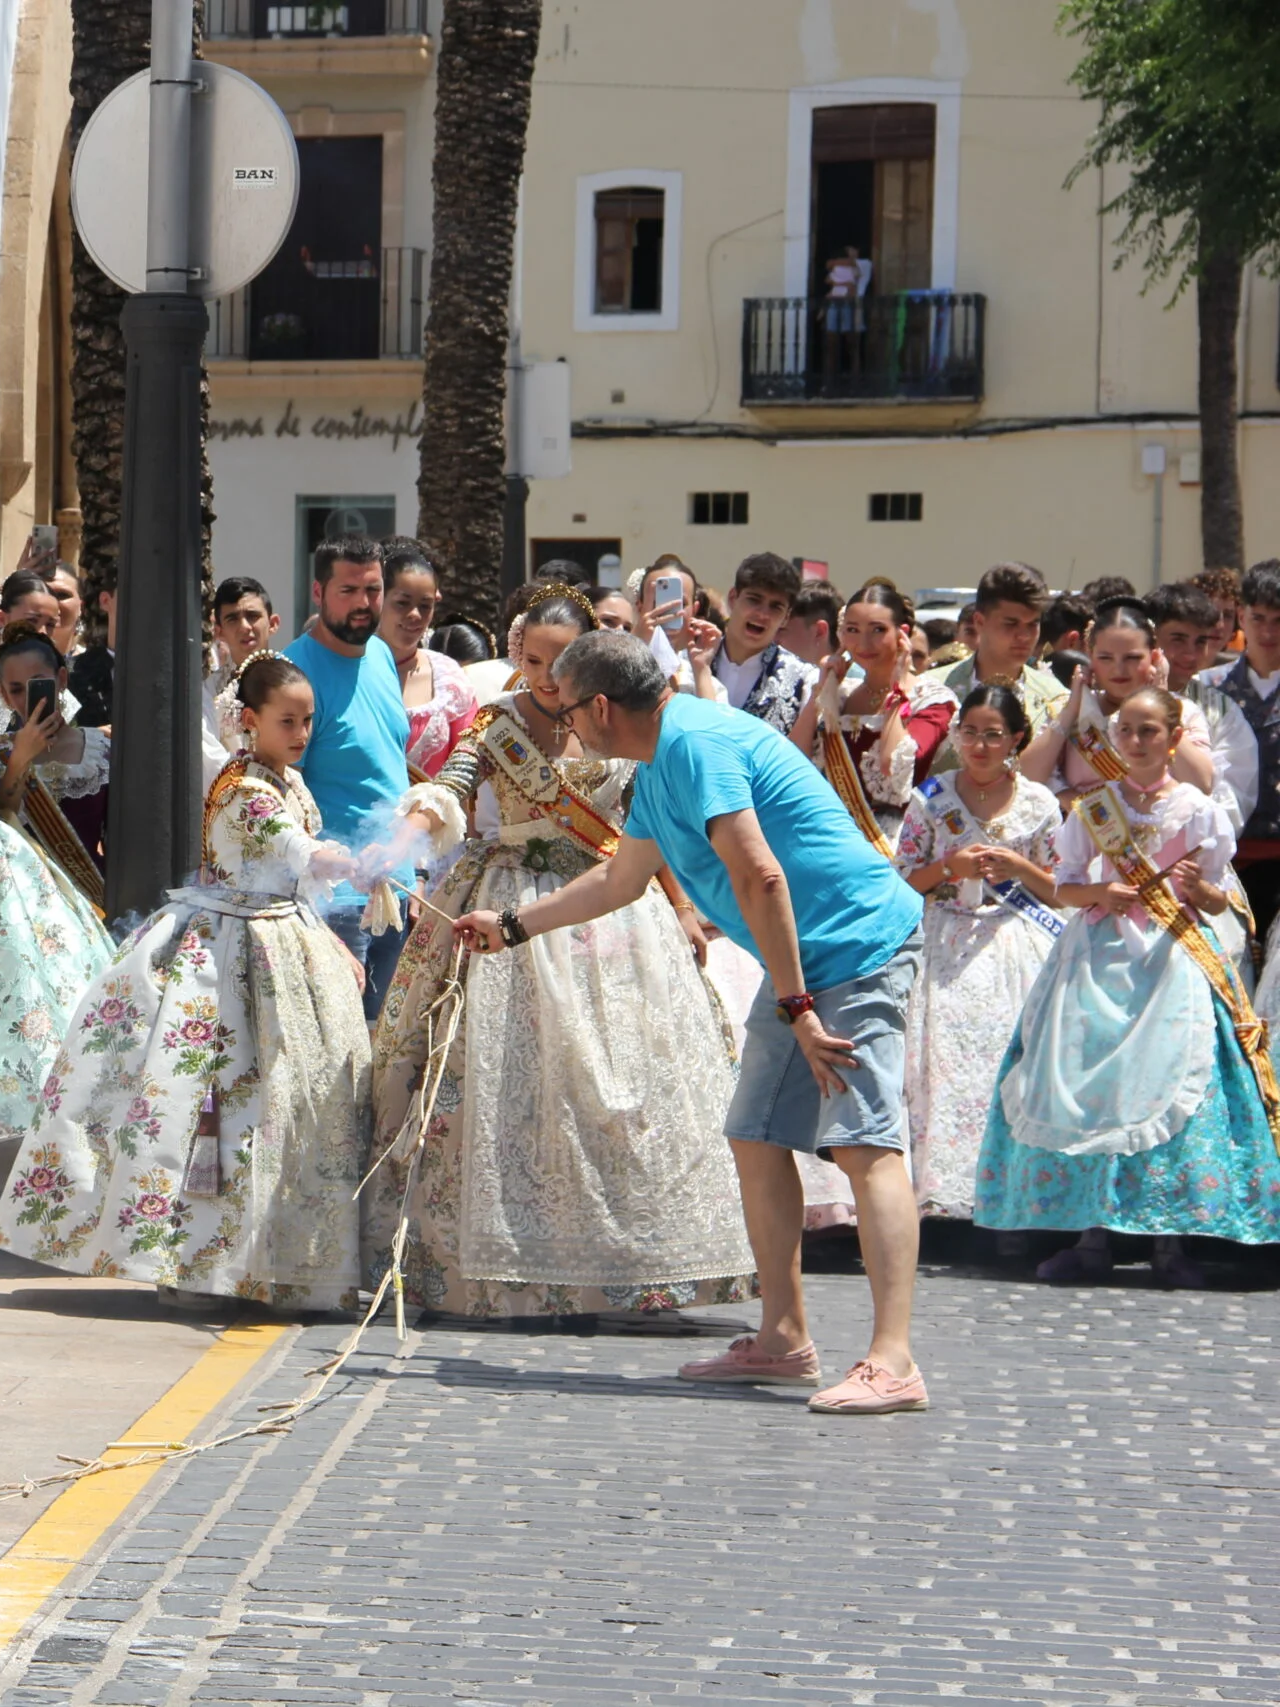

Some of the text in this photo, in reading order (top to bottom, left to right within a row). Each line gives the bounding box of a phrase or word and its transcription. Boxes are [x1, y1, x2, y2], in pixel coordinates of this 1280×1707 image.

[234, 169, 274, 179] BAN
[275, 399, 300, 439] de
[491, 727, 511, 744] 2023
